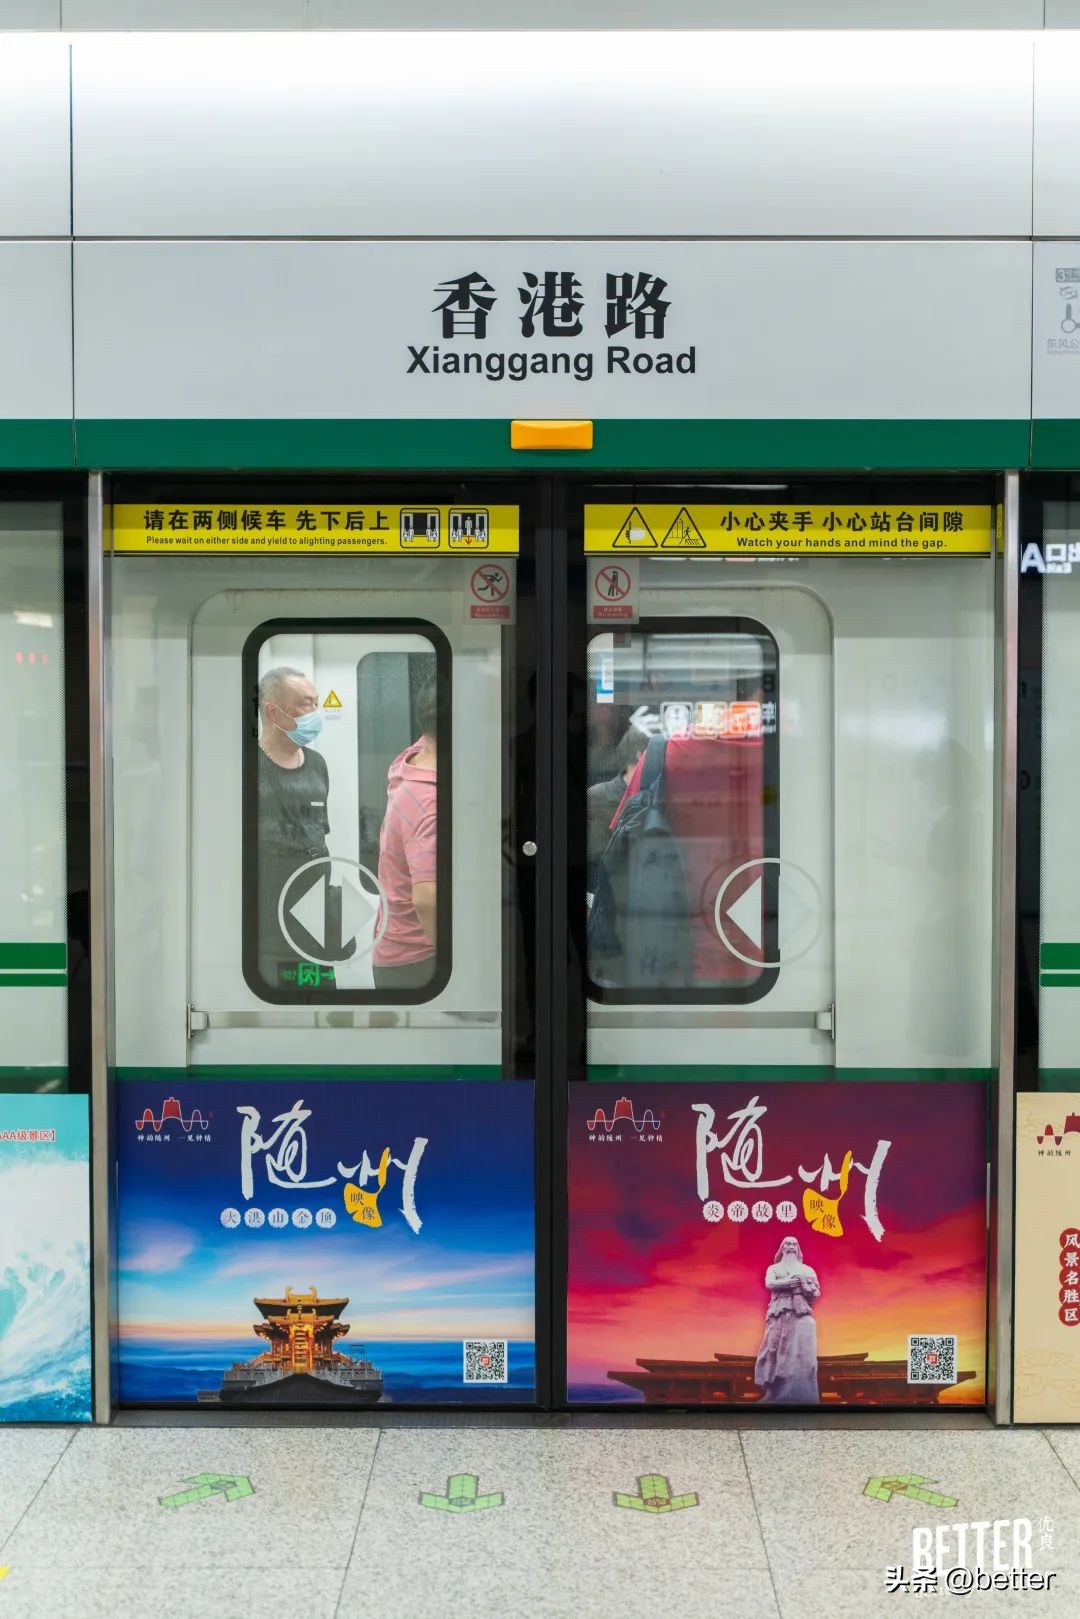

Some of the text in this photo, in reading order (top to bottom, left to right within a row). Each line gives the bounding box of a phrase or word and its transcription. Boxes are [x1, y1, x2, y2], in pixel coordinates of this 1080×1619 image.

[432, 271, 672, 339] 香港路
[406, 345, 697, 382] Xianggang Road
[143, 510, 390, 531] 请在两侧候车 先下后上
[720, 511, 963, 532] 小心夹手 小心站台间隙
[146, 536, 388, 547] Please wait on either side and yield to alighting passengers.
[736, 537, 947, 550] Watch your hands and mind the gap.
[350, 1192, 375, 1220] 映像
[705, 1202, 795, 1220] 炎帝故里
[809, 1199, 837, 1229] 映像
[223, 1210, 334, 1226] 大洪山金顶
[1063, 1233, 1080, 1322] 风景名胜区
